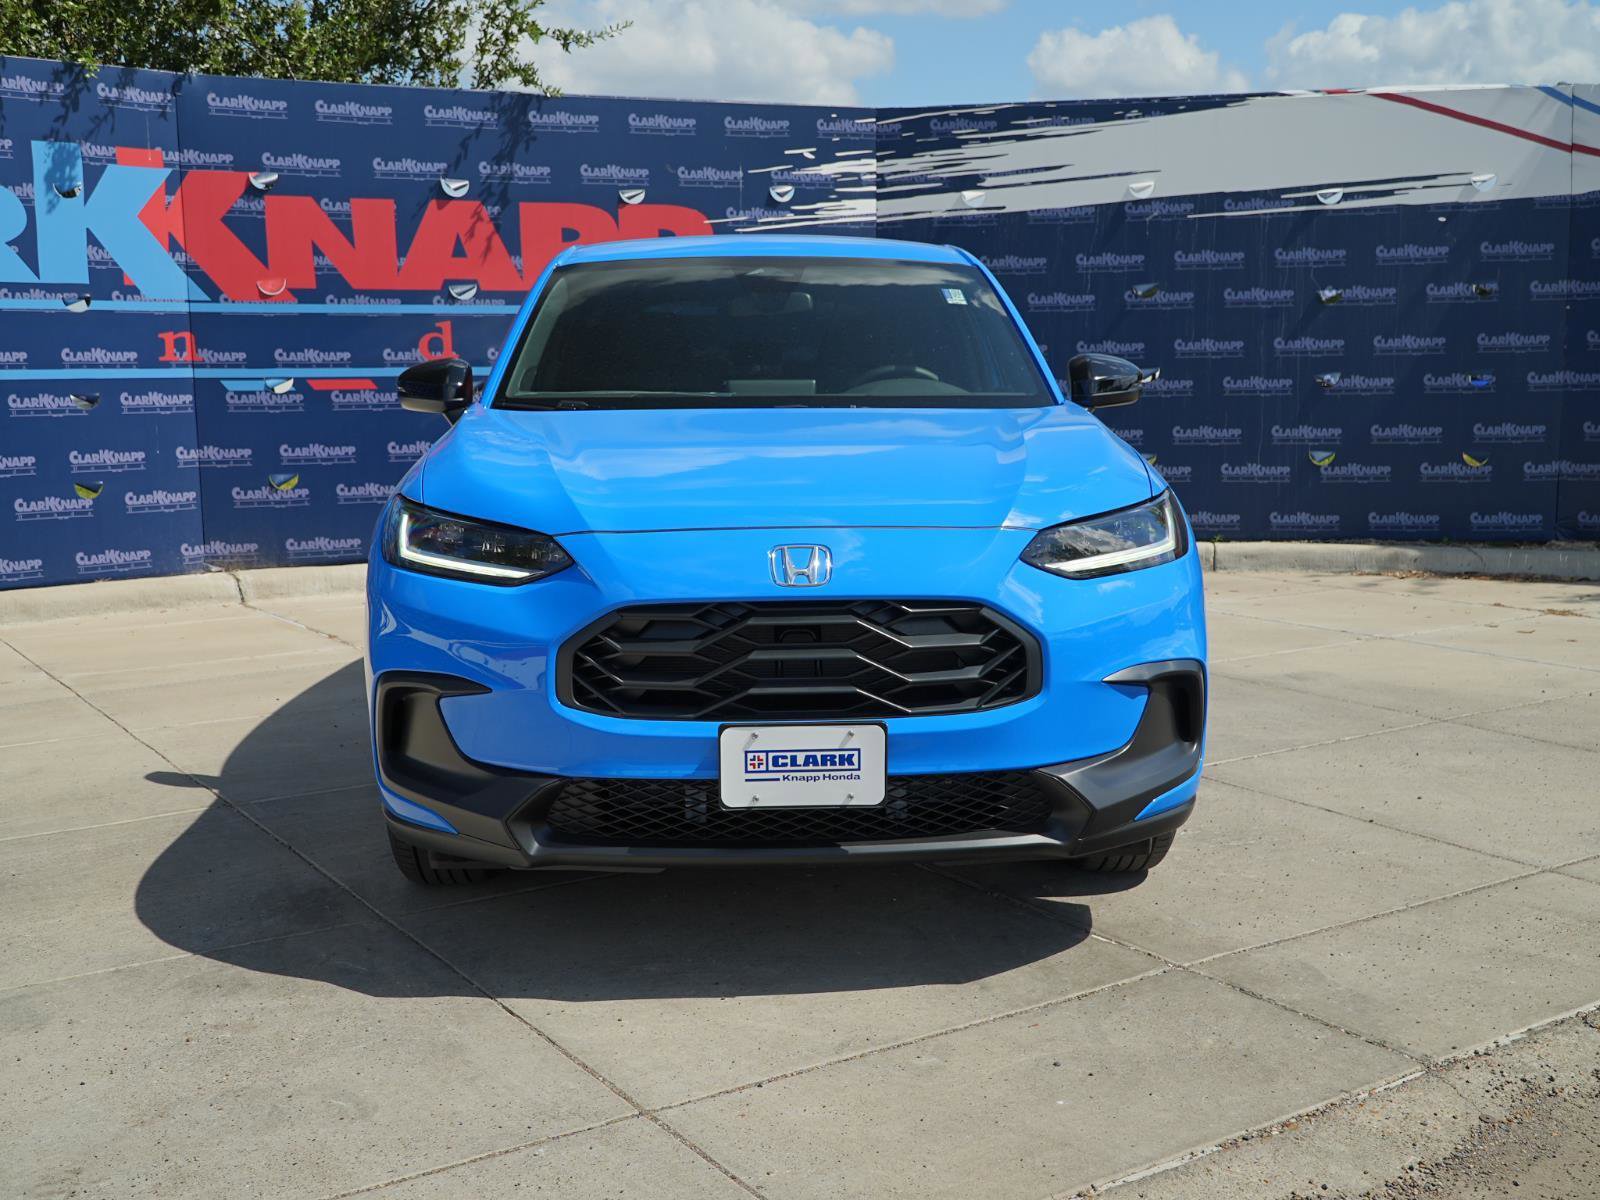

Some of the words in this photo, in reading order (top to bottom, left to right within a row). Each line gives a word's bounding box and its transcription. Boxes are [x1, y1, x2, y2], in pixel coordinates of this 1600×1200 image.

[771, 753, 855, 768] CLARK
[782, 773, 821, 783] Knapp
[823, 772, 861, 782] Honda
